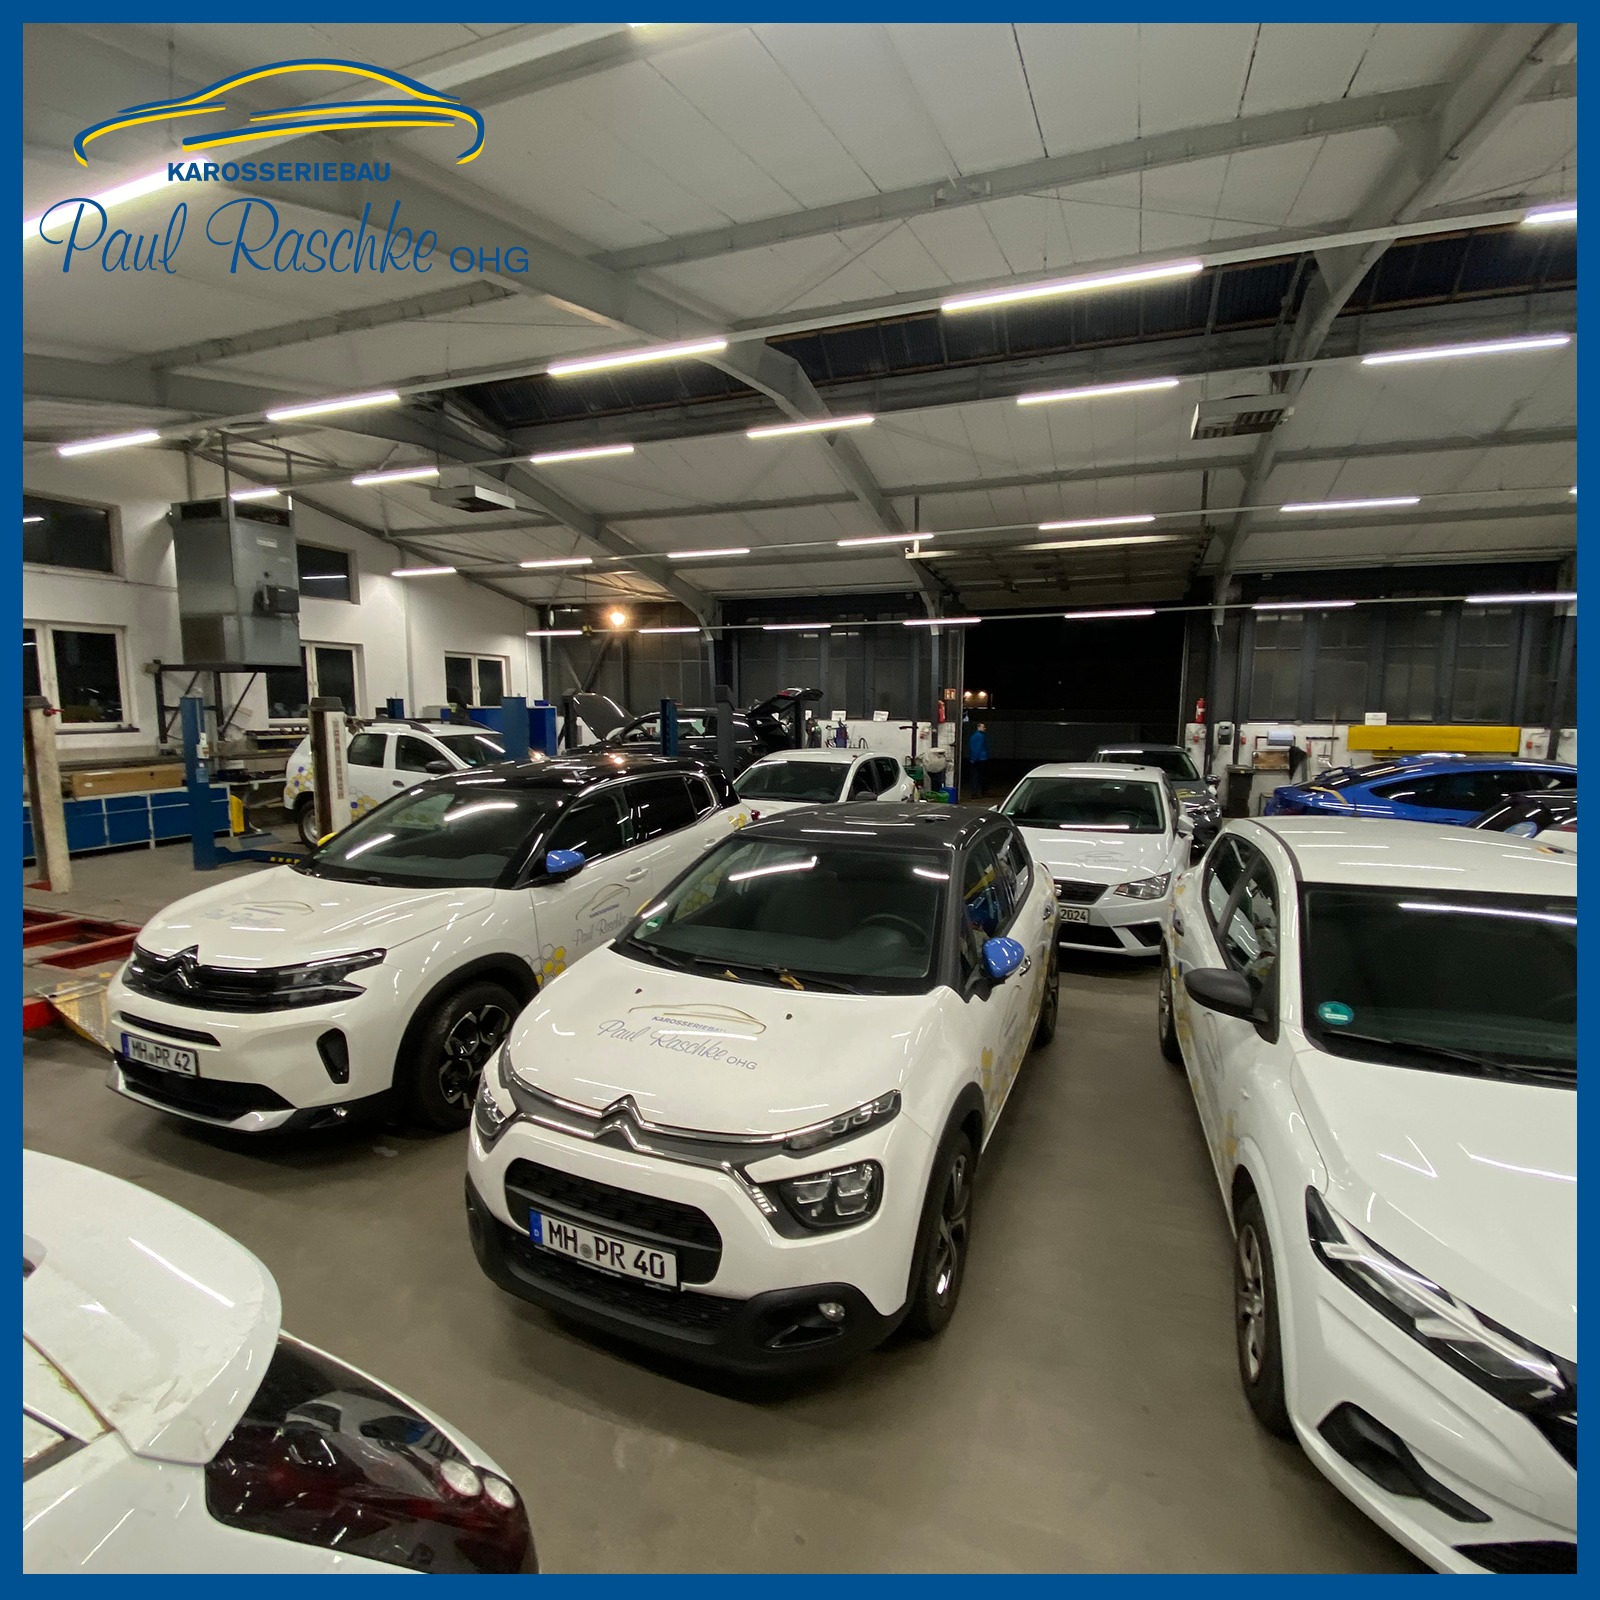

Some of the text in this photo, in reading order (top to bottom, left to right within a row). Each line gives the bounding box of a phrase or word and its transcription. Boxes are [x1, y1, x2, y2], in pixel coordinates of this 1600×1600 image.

[1060, 908, 1087, 921] 2024
[154, 1046, 171, 1067] PR
[174, 1053, 192, 1072] 42
[597, 1020, 758, 1071] Paul Raschke OHG
[548, 1220, 578, 1254] MH
[593, 1236, 626, 1270] PR
[633, 1250, 665, 1279] 40
